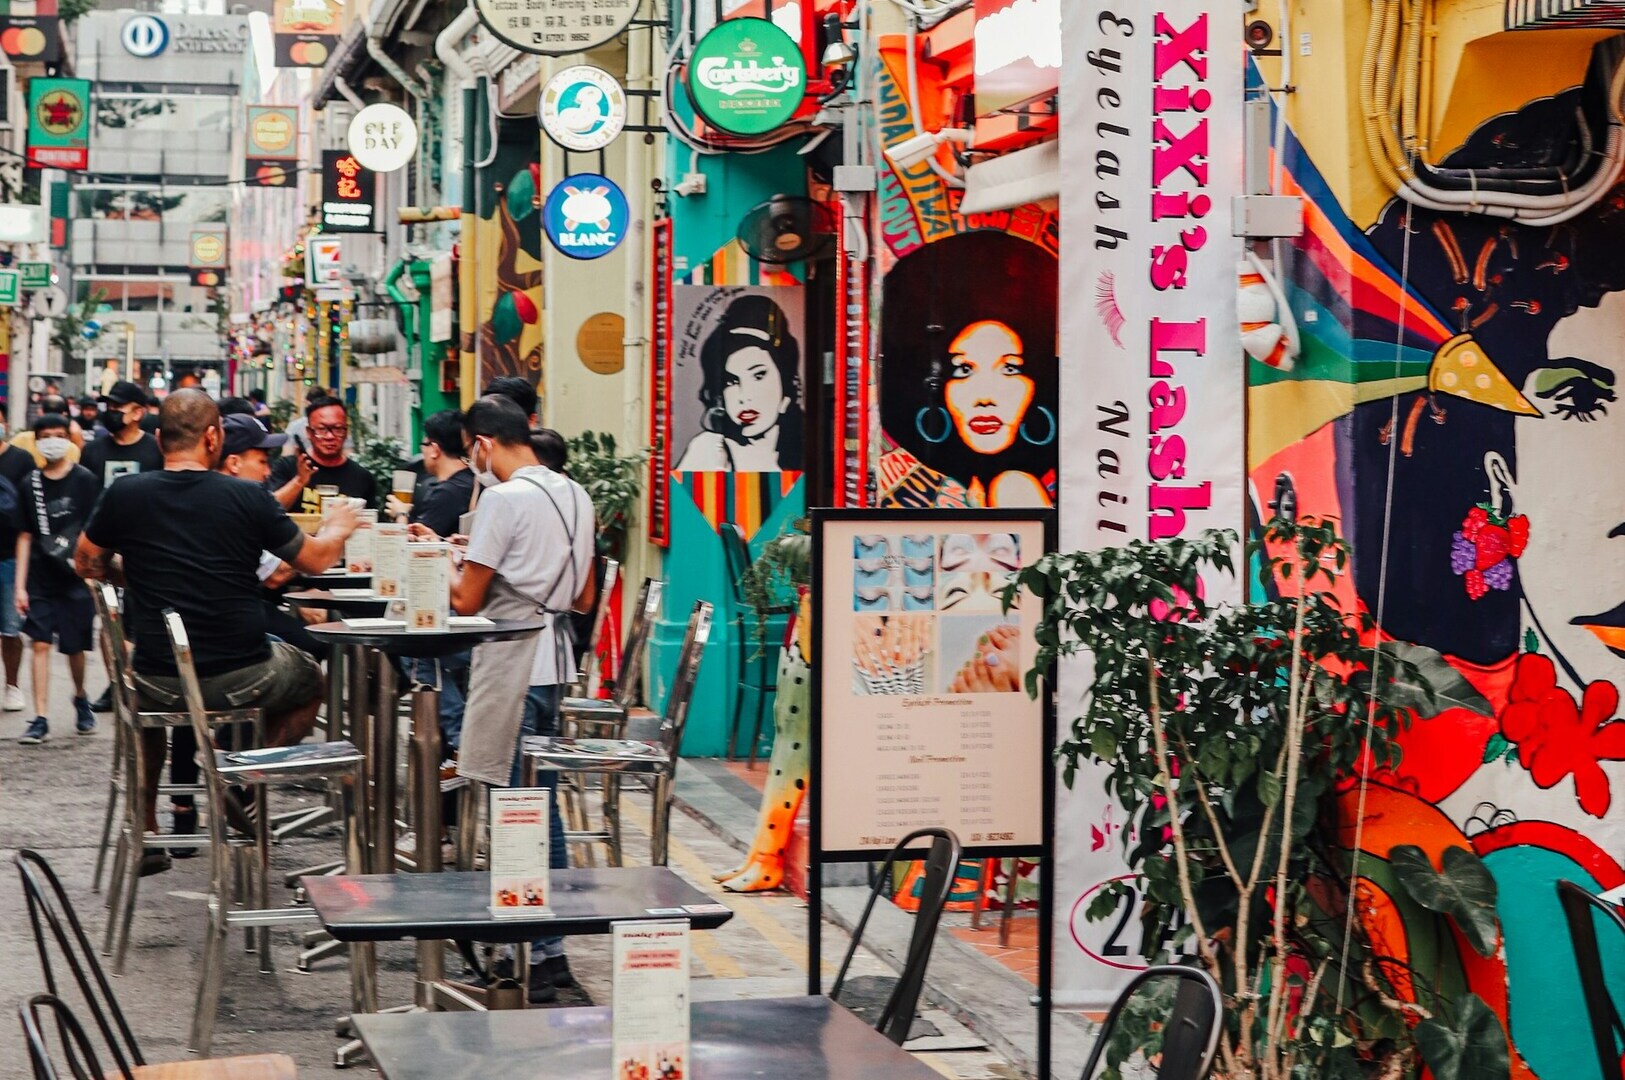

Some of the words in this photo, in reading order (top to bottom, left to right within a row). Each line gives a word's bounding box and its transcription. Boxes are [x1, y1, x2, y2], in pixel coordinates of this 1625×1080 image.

[697, 56, 800, 94] Carlsberg
[1087, 10, 1135, 251] Eyelash
[365, 138, 400, 149] DAY
[1150, 12, 1212, 291] XiXi's
[559, 232, 616, 246] BLANC
[1096, 400, 1131, 533] Nail
[1148, 317, 1213, 543] Lash
